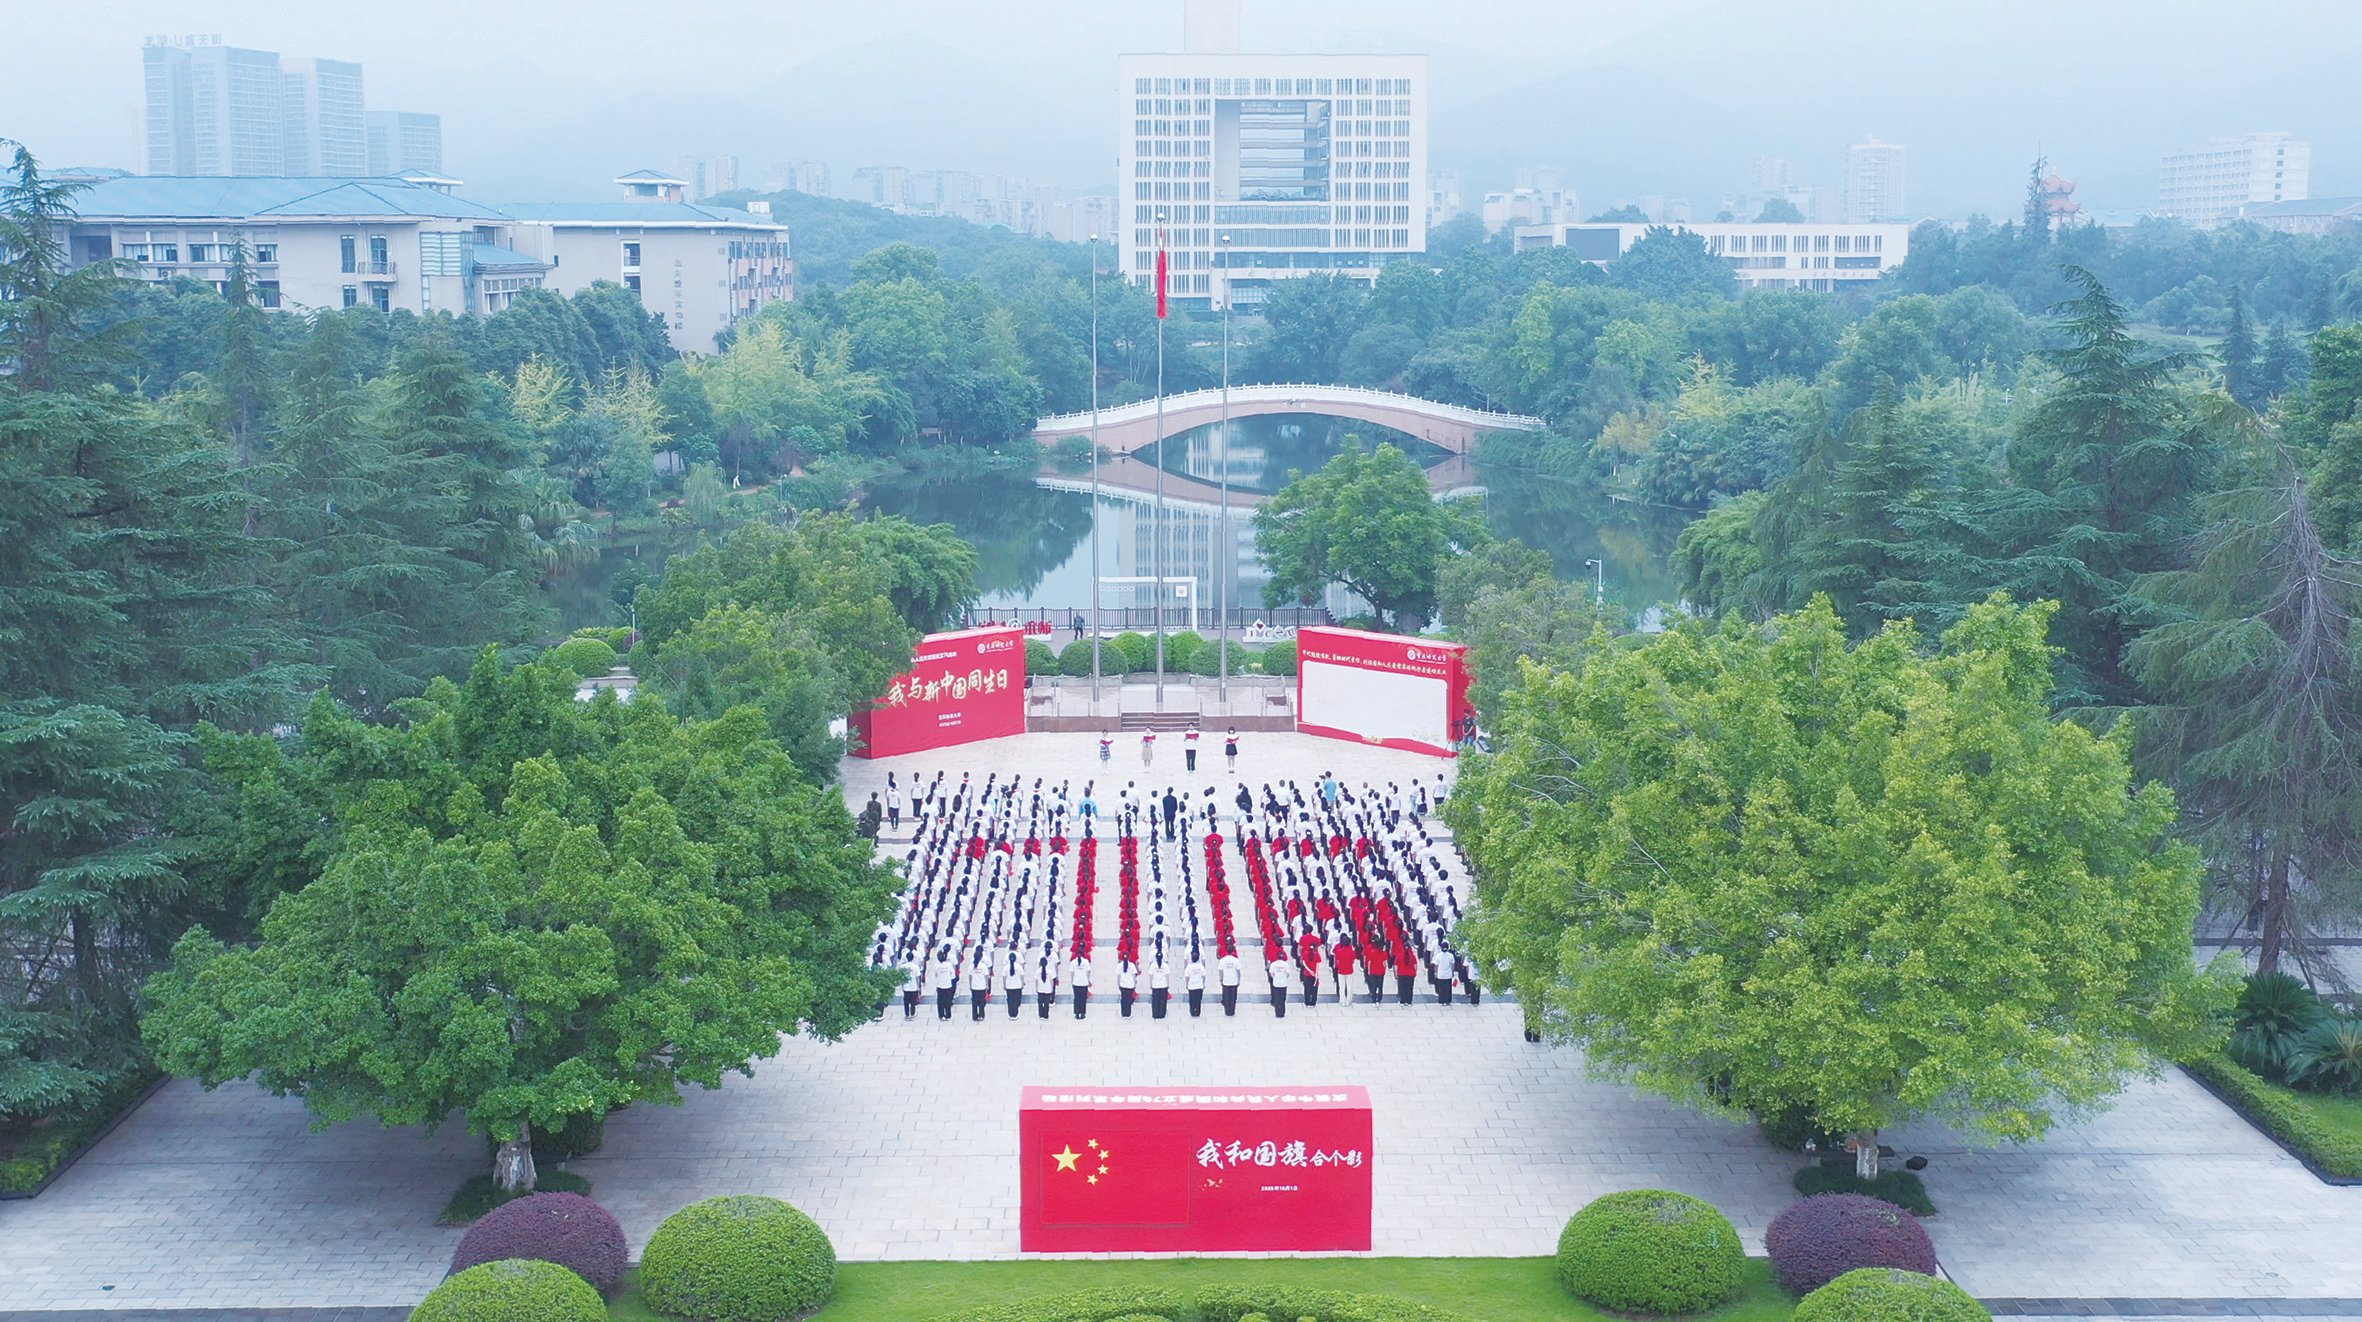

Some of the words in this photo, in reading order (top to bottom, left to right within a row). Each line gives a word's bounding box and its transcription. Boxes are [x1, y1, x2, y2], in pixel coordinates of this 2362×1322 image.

[888, 668, 1008, 708] 我与新中国同生日
[1195, 1138, 1363, 1169] 我和国旗合个影
